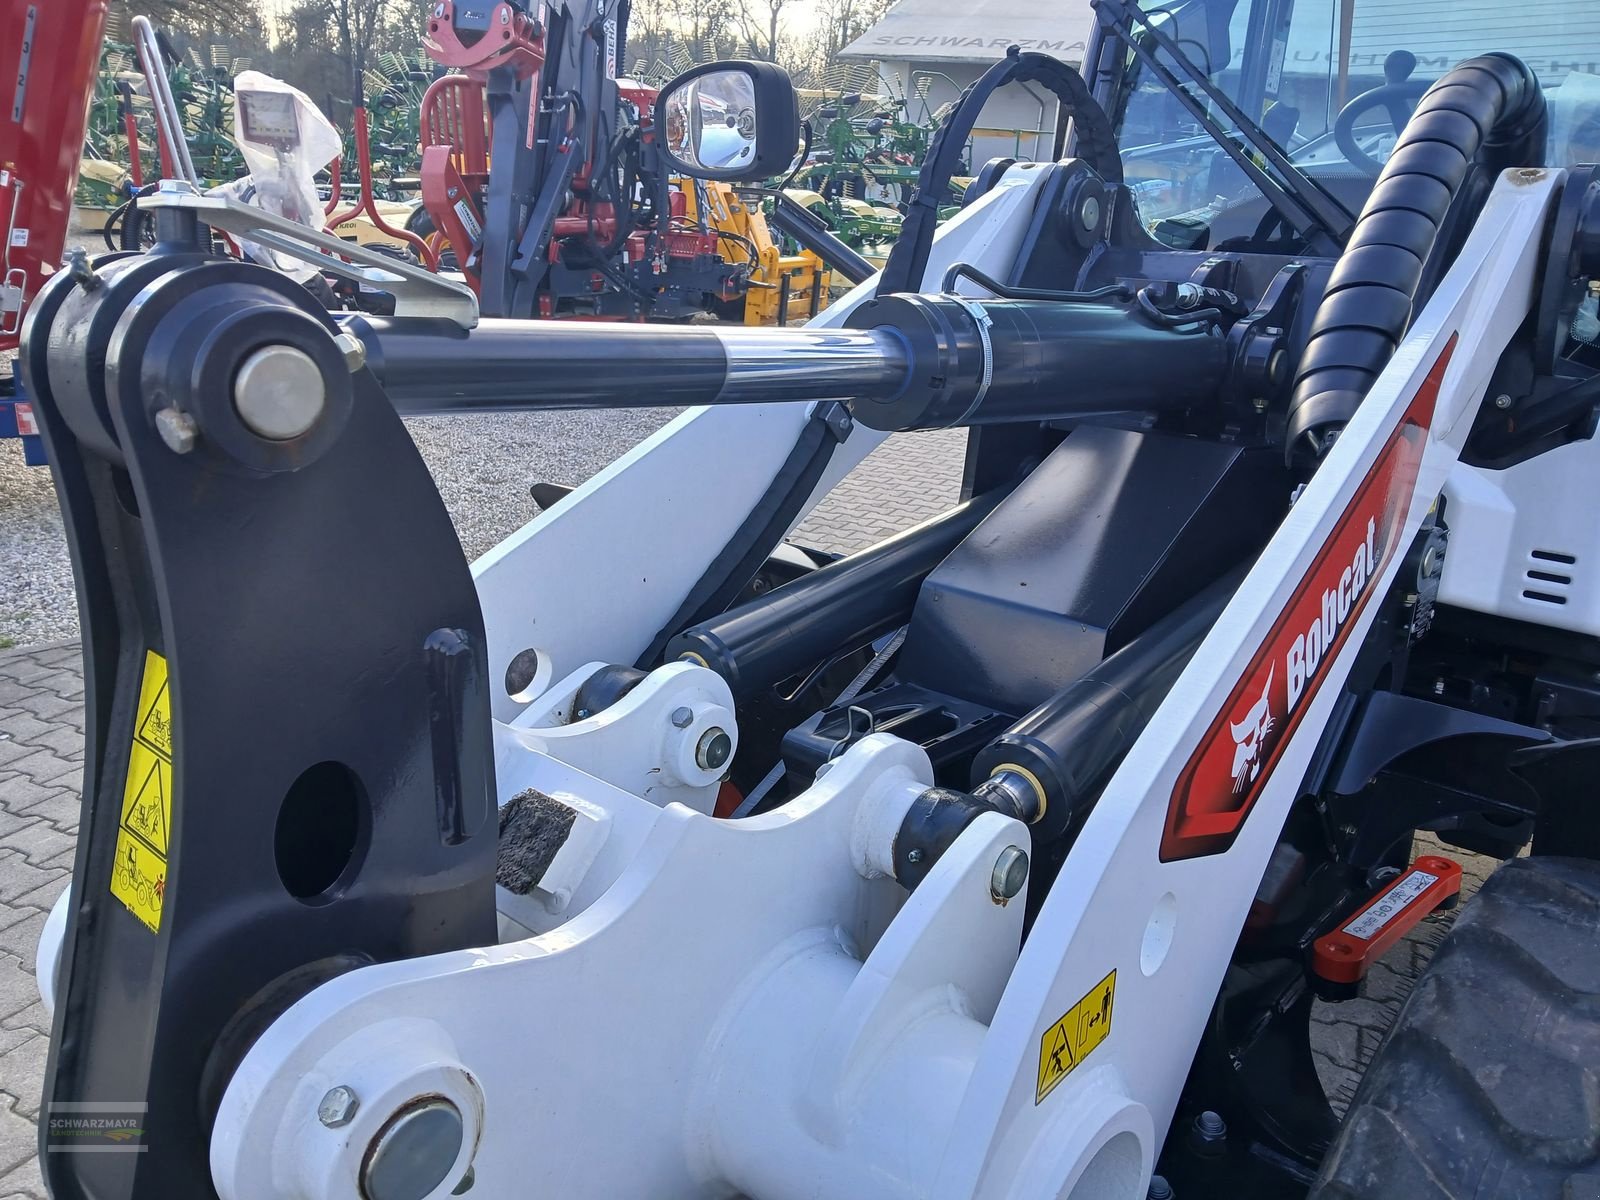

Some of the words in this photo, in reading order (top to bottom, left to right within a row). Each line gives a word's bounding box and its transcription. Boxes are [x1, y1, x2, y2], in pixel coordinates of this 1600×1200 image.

[28, 9, 34, 21] 4
[22, 41, 30, 54] 3
[18, 74, 25, 87] 2
[14, 106, 20, 119] 1
[1286, 515, 1376, 715] Bobcat
